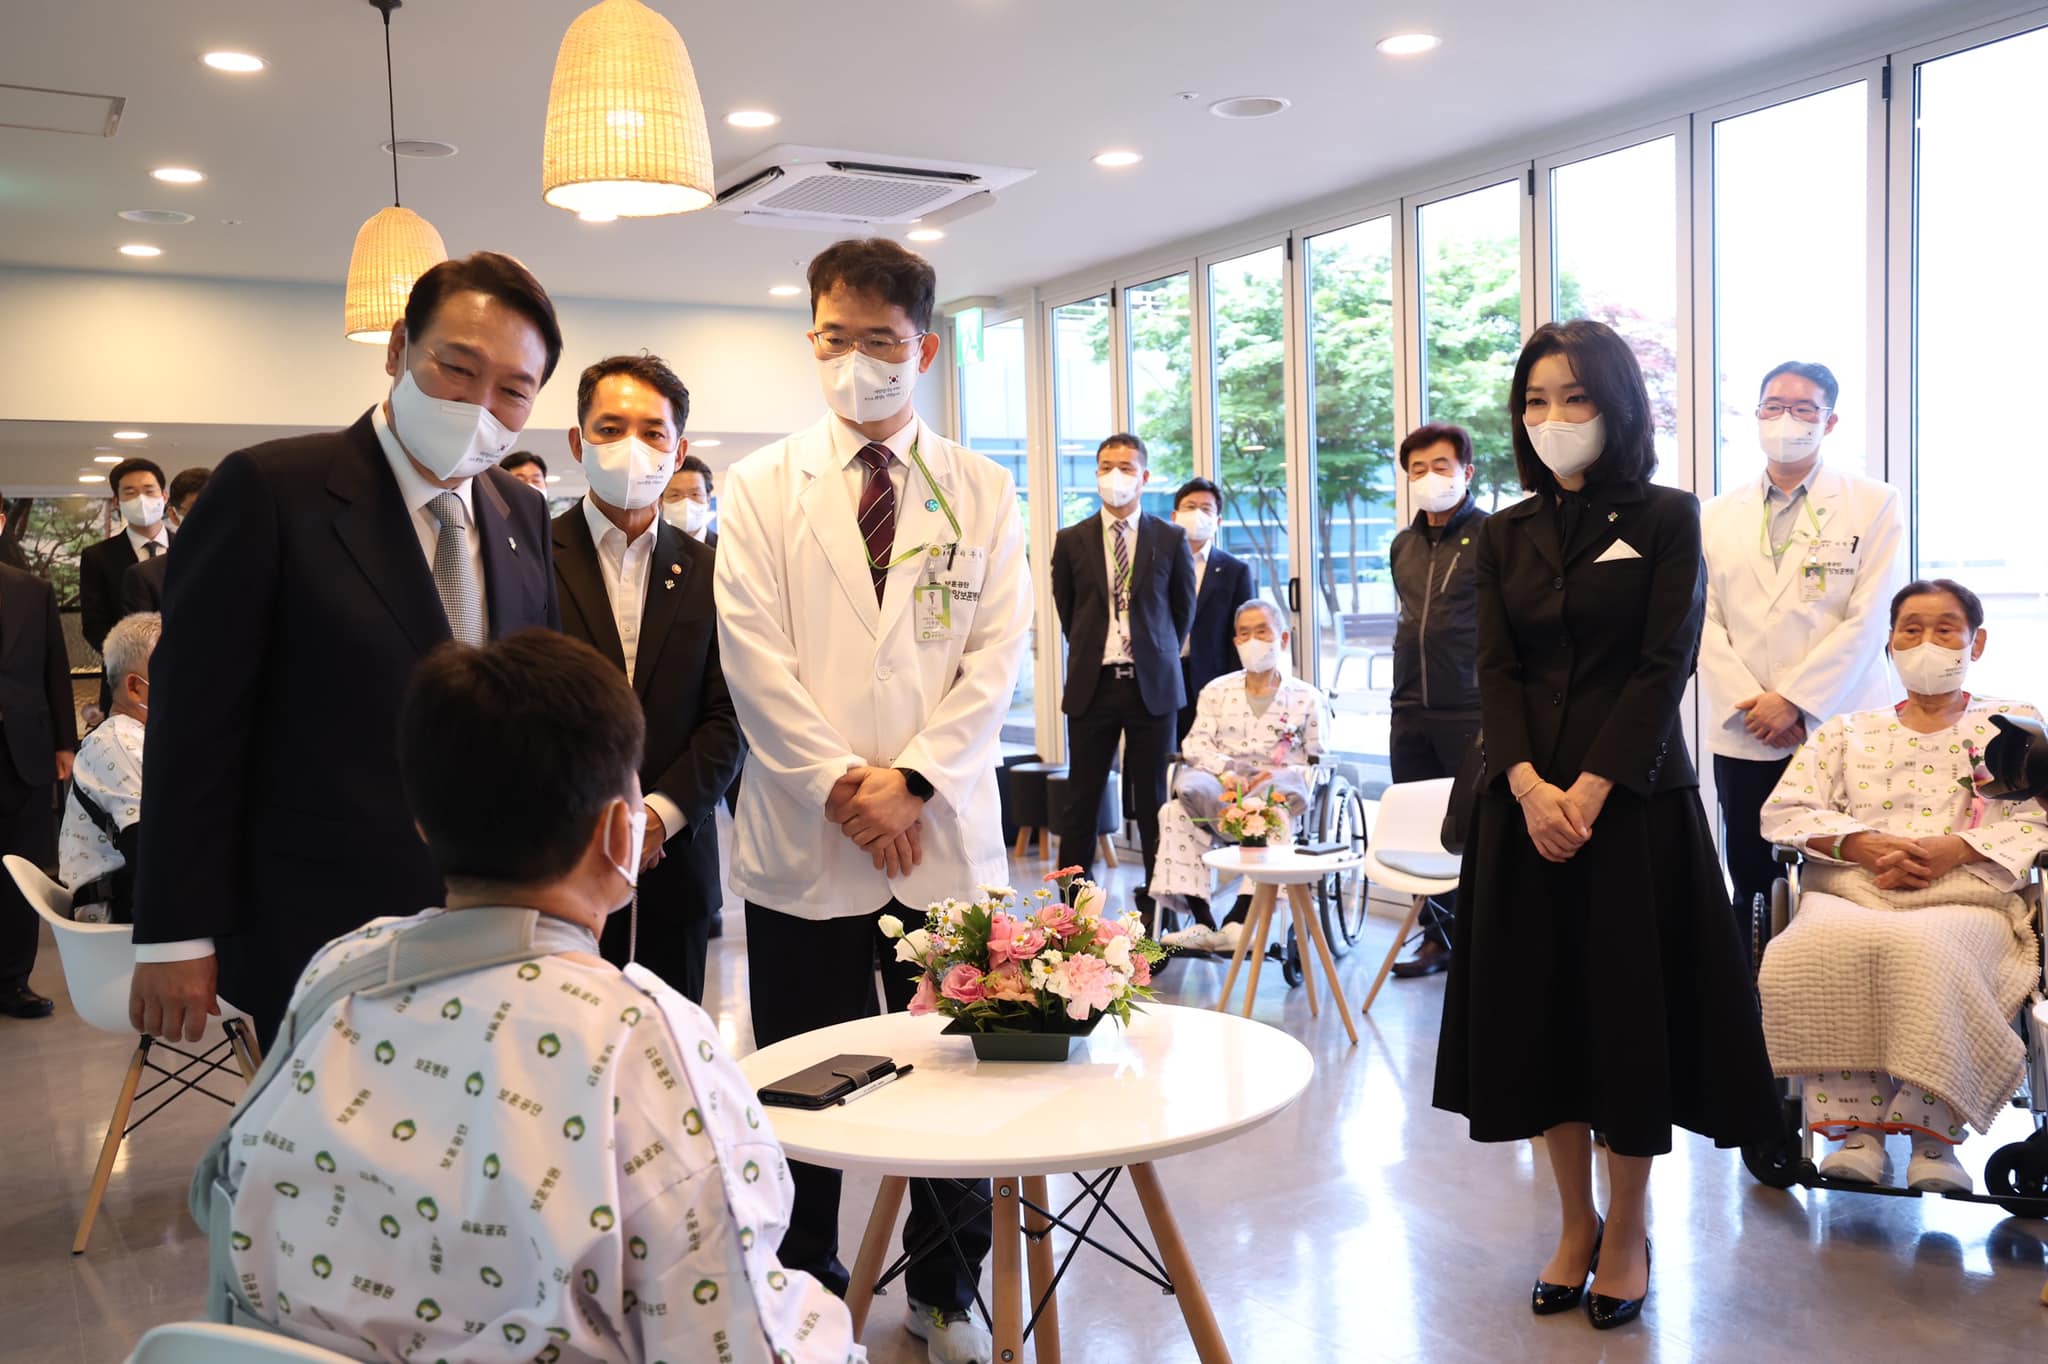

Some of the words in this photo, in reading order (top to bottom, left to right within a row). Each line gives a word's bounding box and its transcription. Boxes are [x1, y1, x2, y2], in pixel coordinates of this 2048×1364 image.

[414, 1057, 450, 1080] 보훈병원
[496, 1086, 544, 1118] 보훈공단
[712, 1329, 734, 1364] 훈병원
